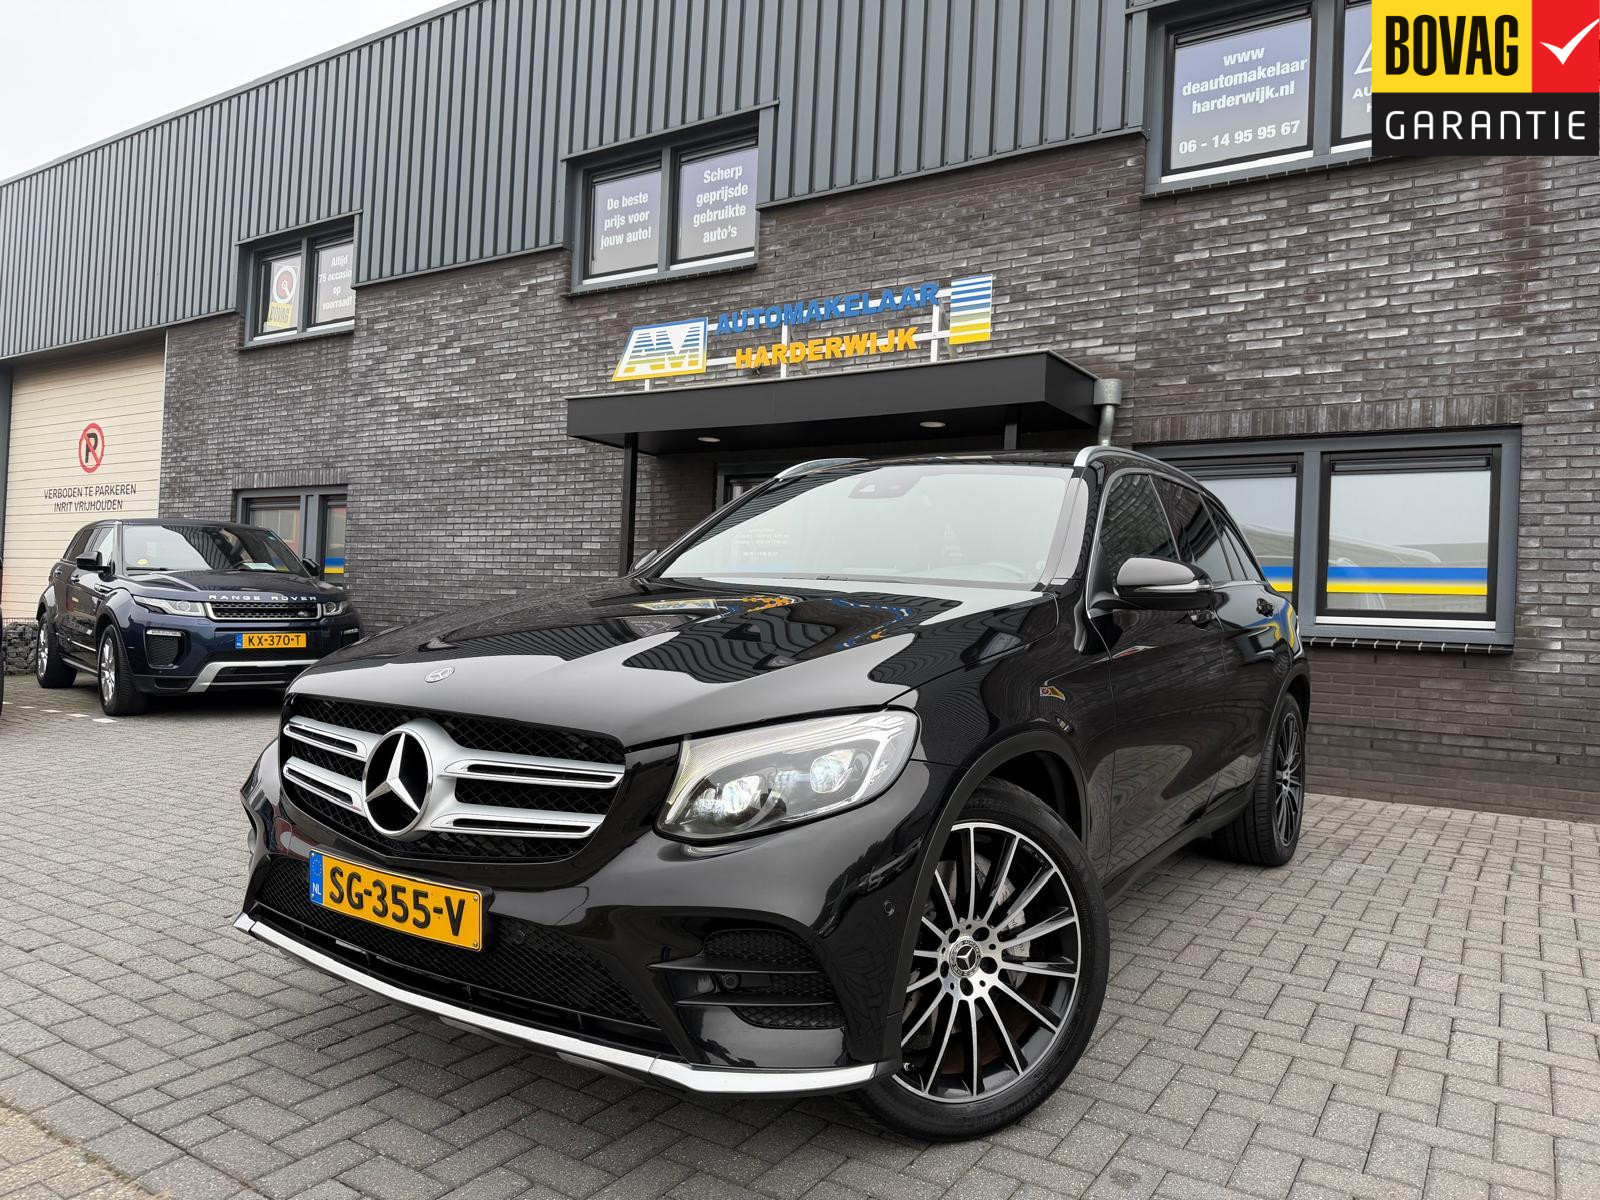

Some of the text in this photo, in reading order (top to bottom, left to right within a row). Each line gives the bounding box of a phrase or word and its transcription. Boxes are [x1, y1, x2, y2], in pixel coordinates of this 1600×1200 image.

[1223, 45, 1265, 67] www
[1182, 57, 1308, 98] deautomakelaar
[1191, 81, 1296, 116] harderwijk.nl
[1178, 136, 1197, 154] 06
[1212, 132, 1230, 149] 14
[1234, 128, 1254, 146] 95
[1257, 124, 1278, 143] 95
[1281, 120, 1301, 138] 67
[703, 165, 743, 184] Scherp
[607, 191, 649, 211] De beste
[696, 183, 749, 207] geprijsde
[604, 211, 650, 231] prijs voor
[693, 203, 747, 228] gebruikte
[600, 226, 652, 250] jouw auto!
[702, 225, 738, 244] auto's
[716, 282, 940, 336] AUTOMAKELAAR
[735, 326, 919, 370] HARDERWIJK
[43, 484, 137, 500] VERBODEN TE PARKEREN
[53, 499, 123, 512] INRIT VRIJHOUDEN
[248, 635, 302, 647] KX-370-T
[312, 866, 466, 937] NL SG-355-V
